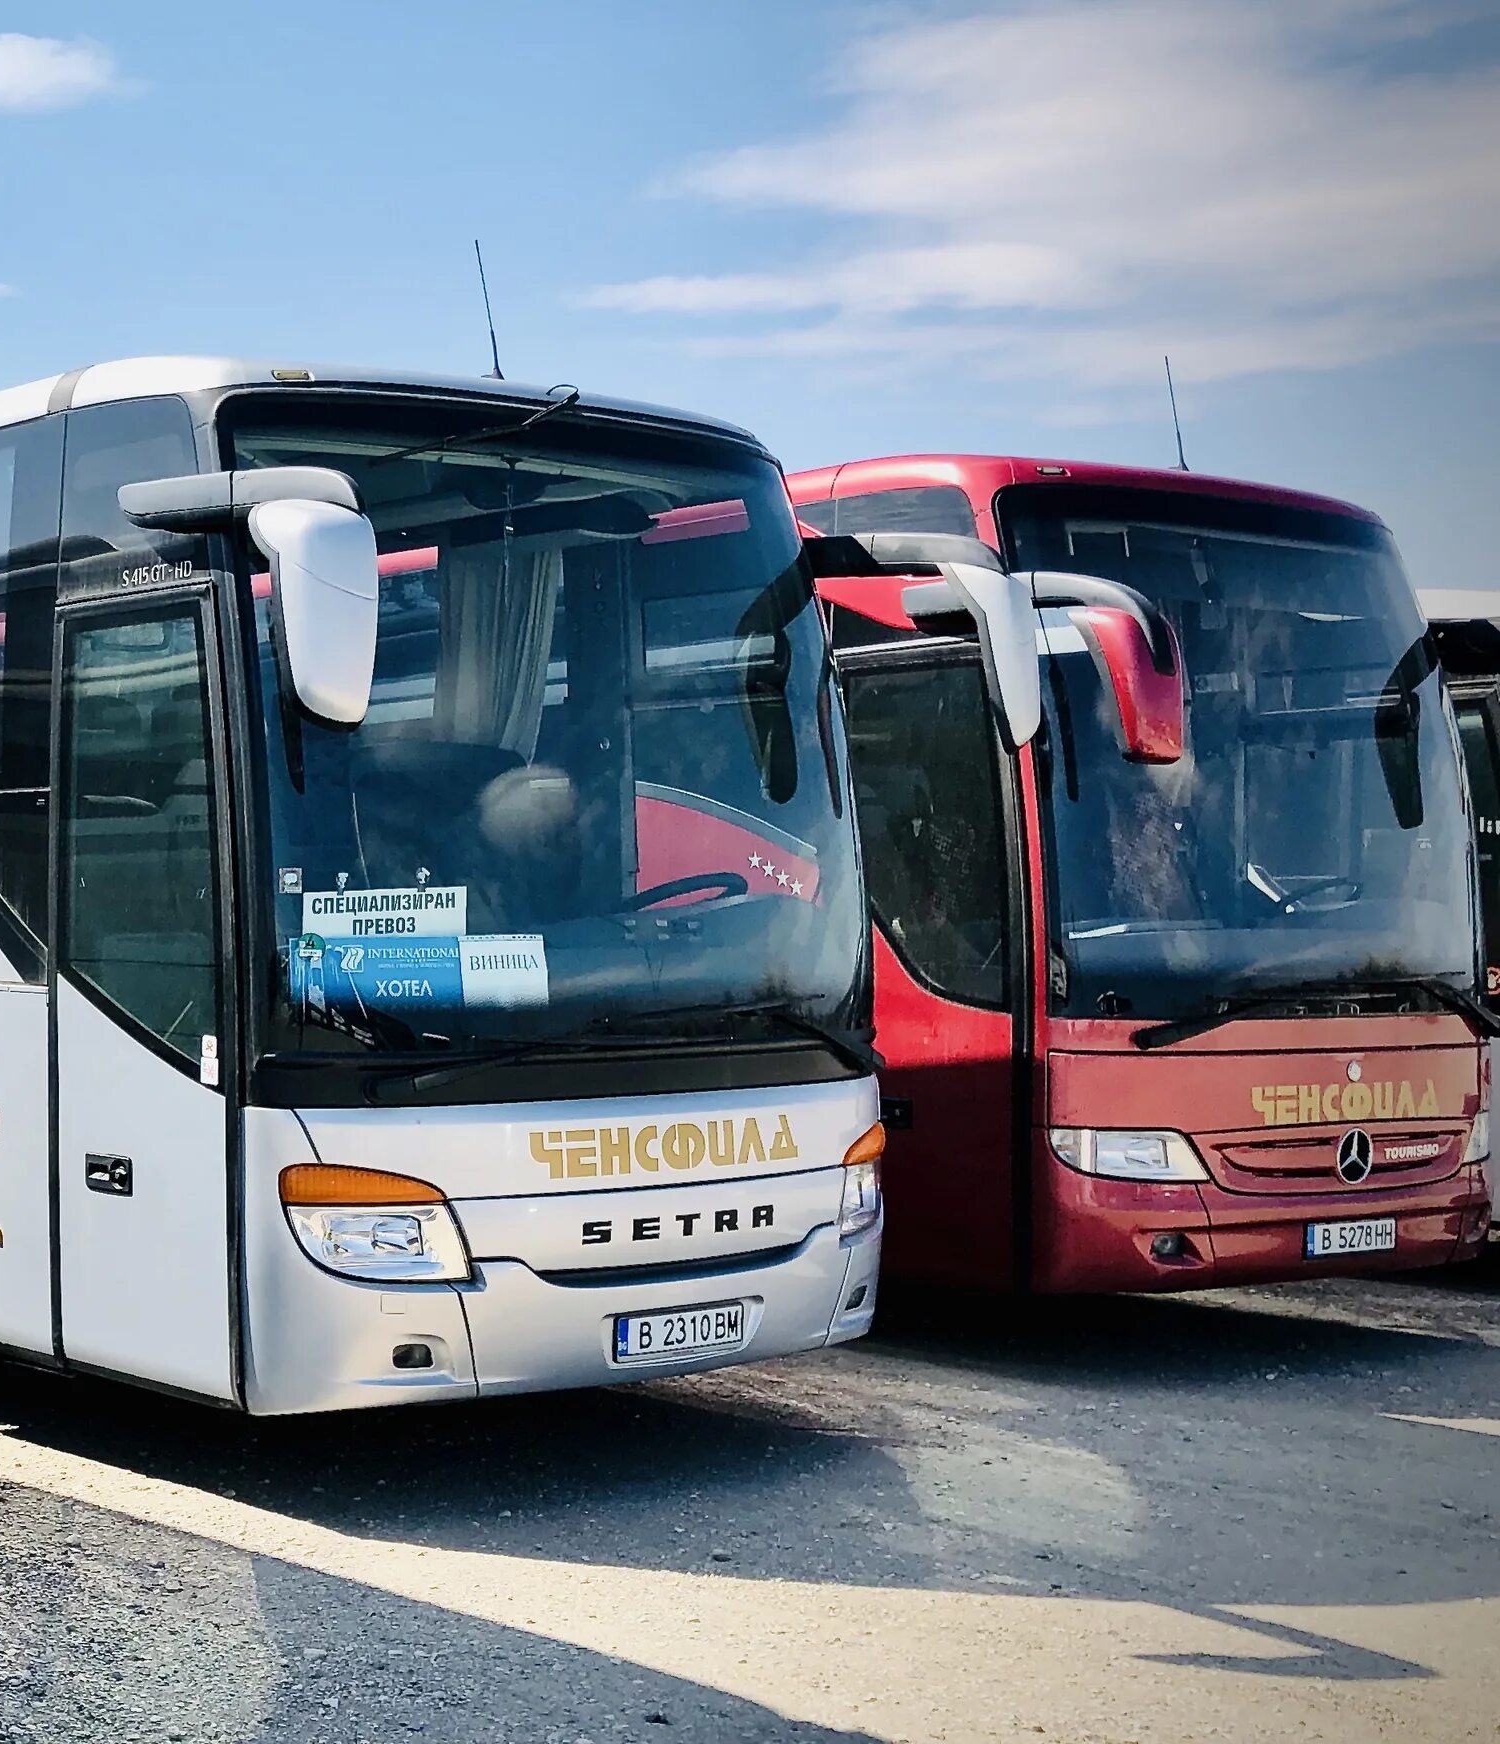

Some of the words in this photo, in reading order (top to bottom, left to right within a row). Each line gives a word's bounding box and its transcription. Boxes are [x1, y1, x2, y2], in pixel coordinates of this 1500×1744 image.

[311, 891, 457, 917] СПЕЦИАЛИЗИРАН
[351, 916, 417, 936] ПРЕВОЗ
[469, 954, 539, 972] ВИНИЦА
[375, 979, 433, 998] ХОТЕЛ
[1253, 1078, 1440, 1126] ЧЕНСФИЛД
[528, 1114, 799, 1180] ЧЕНСФИЛД
[1384, 1143, 1439, 1160] TOURISMO
[581, 1204, 775, 1246] SETRA
[663, 1314, 711, 1347] 2310
